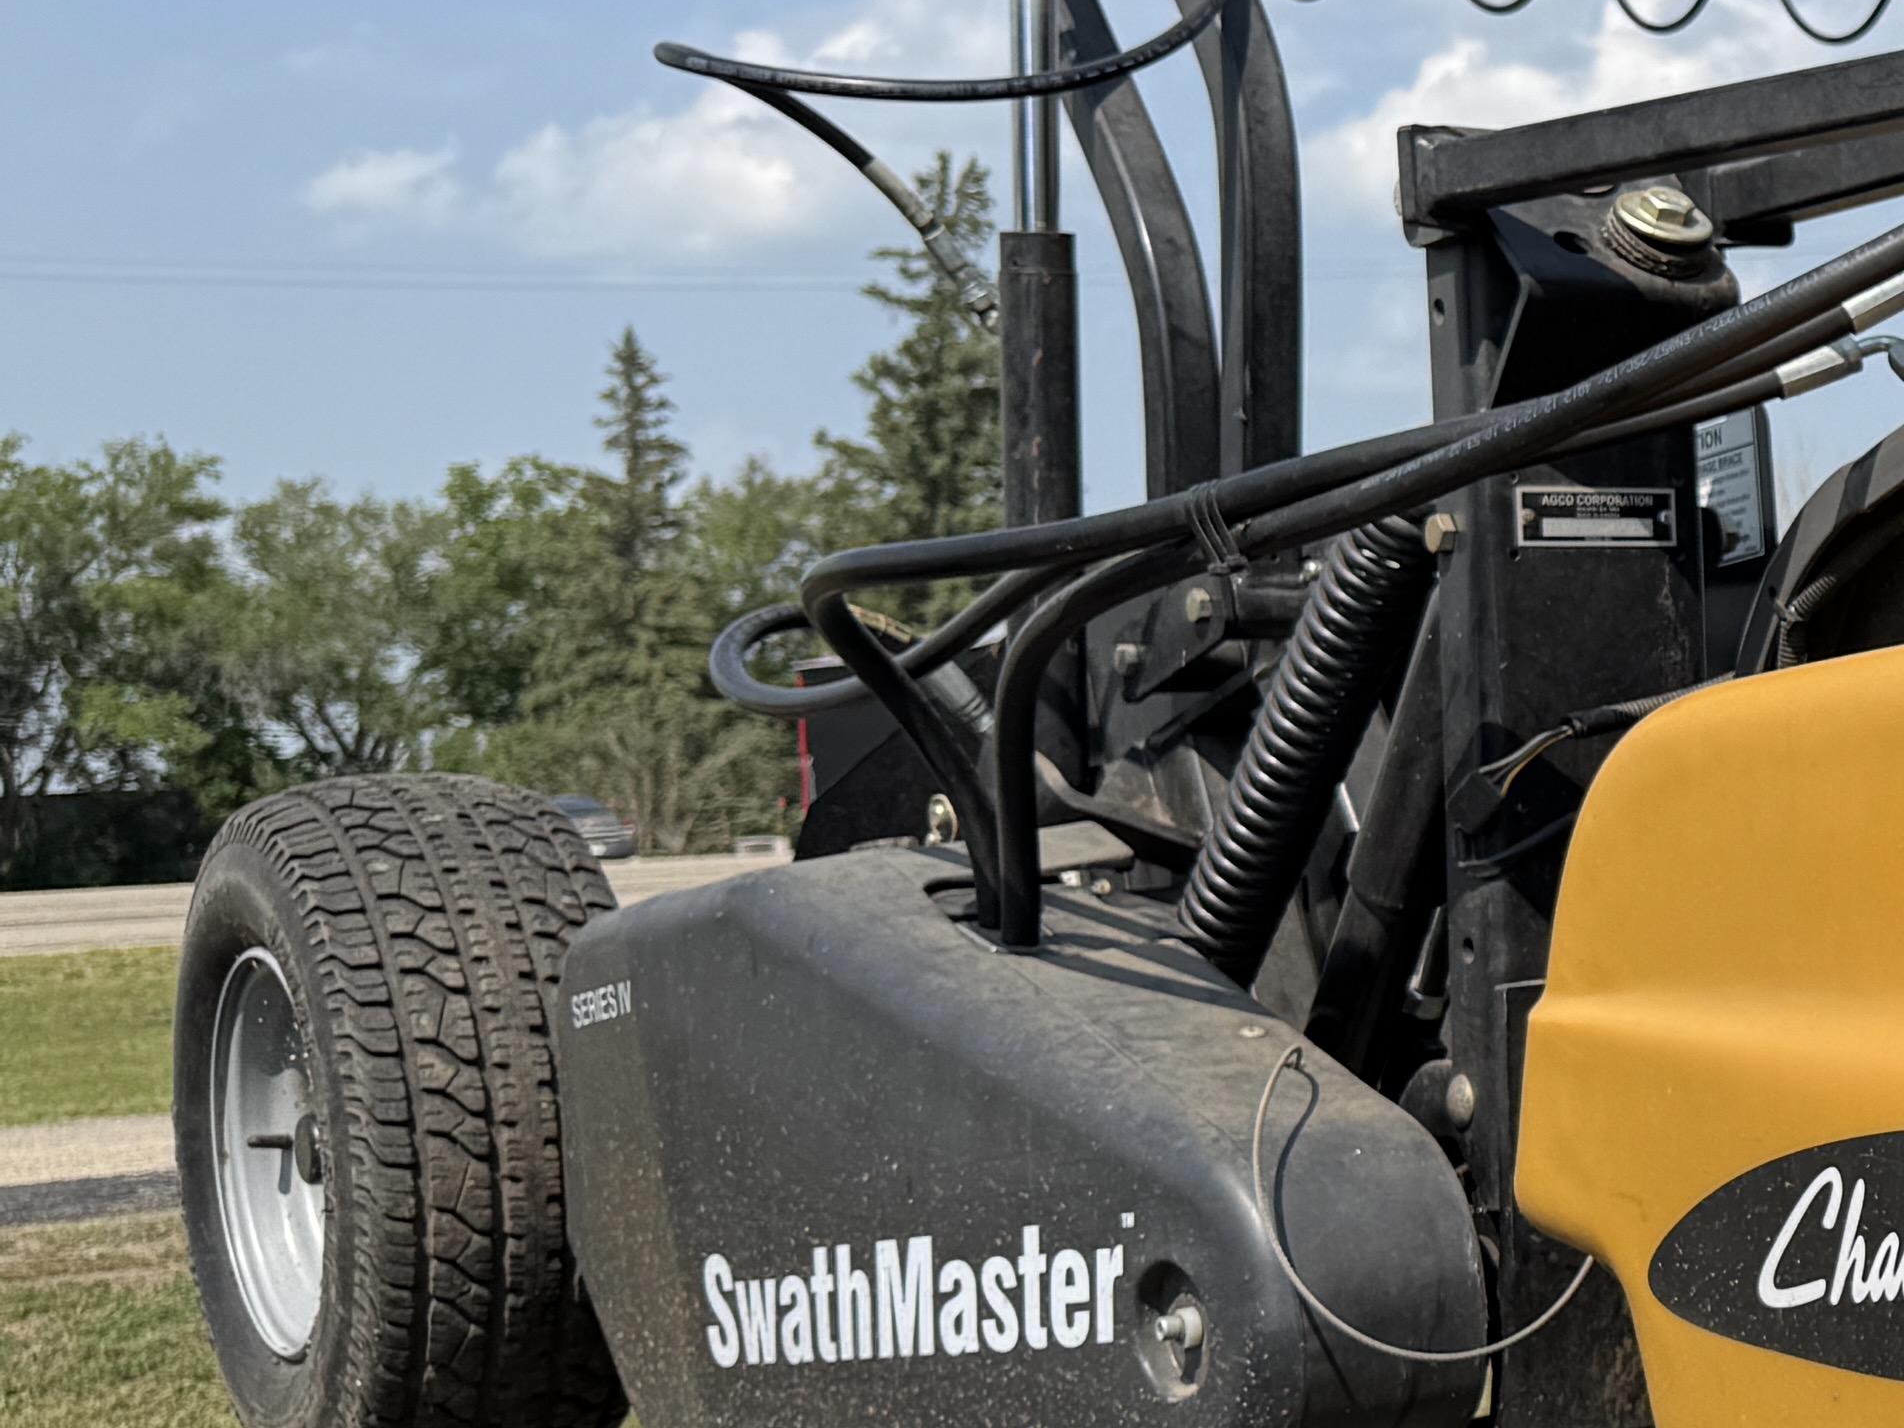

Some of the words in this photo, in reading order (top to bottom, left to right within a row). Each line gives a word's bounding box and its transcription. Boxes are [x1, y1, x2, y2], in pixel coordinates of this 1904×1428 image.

[1541, 494, 1574, 507] AGCO
[1576, 494, 1653, 507] CORPORATION
[571, 984, 618, 1029] SERIES
[703, 1224, 1124, 1368] SwathMaster
